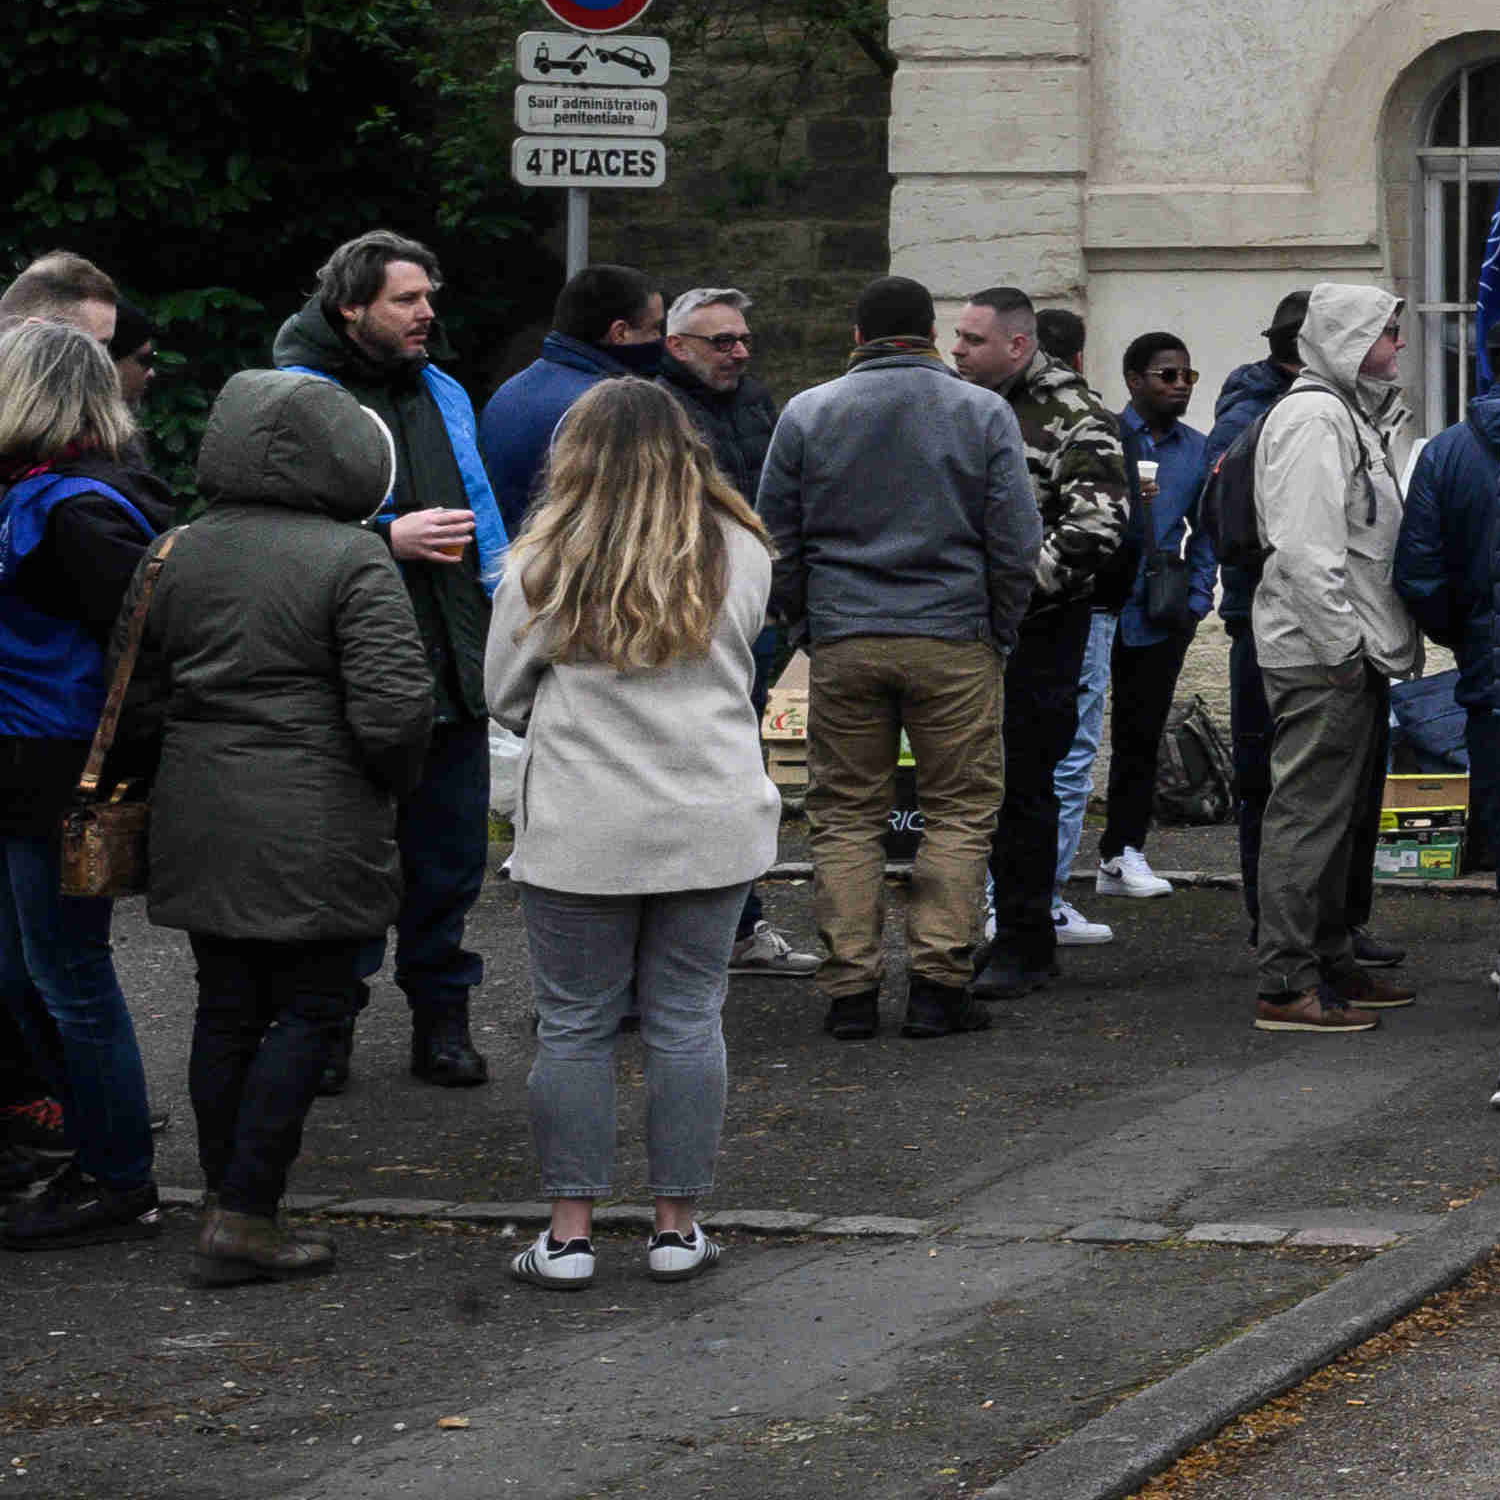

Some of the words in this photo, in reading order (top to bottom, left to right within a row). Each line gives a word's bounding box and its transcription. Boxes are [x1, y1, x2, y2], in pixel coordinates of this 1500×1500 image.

[528, 95, 558, 108] Sauf
[563, 97, 658, 112] administration
[526, 148, 542, 176] 4
[552, 148, 657, 177] PLACES
